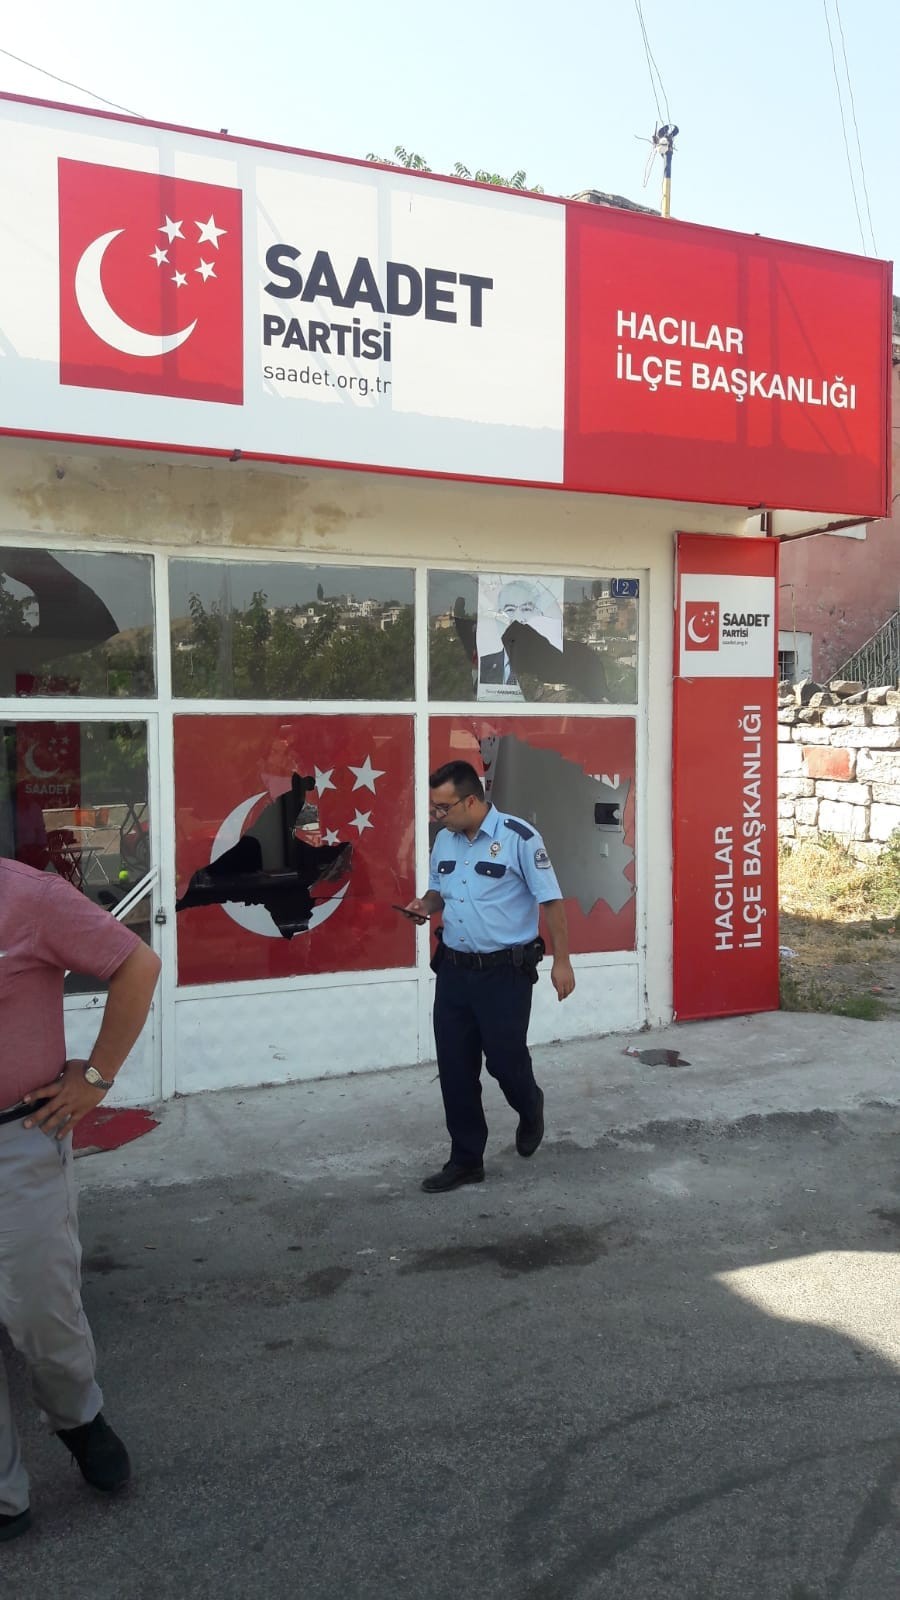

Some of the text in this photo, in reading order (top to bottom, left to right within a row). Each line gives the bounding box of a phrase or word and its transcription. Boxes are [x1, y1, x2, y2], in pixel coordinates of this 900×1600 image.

[263, 243, 493, 328] SAADET
[263, 314, 391, 362] PARTİSİ
[616, 310, 744, 354] HACILAR
[263, 365, 392, 396] saadet.org.tr
[616, 345, 856, 410] İLÇE BAŞKANLIĞI
[722, 628, 748, 638] PARTİSİ
[723, 613, 770, 627] SAADET
[25, 784, 71, 795] SAADET
[738, 705, 766, 948] İLÇE BAŞKANLIĞI
[715, 826, 734, 950] HACILAR
